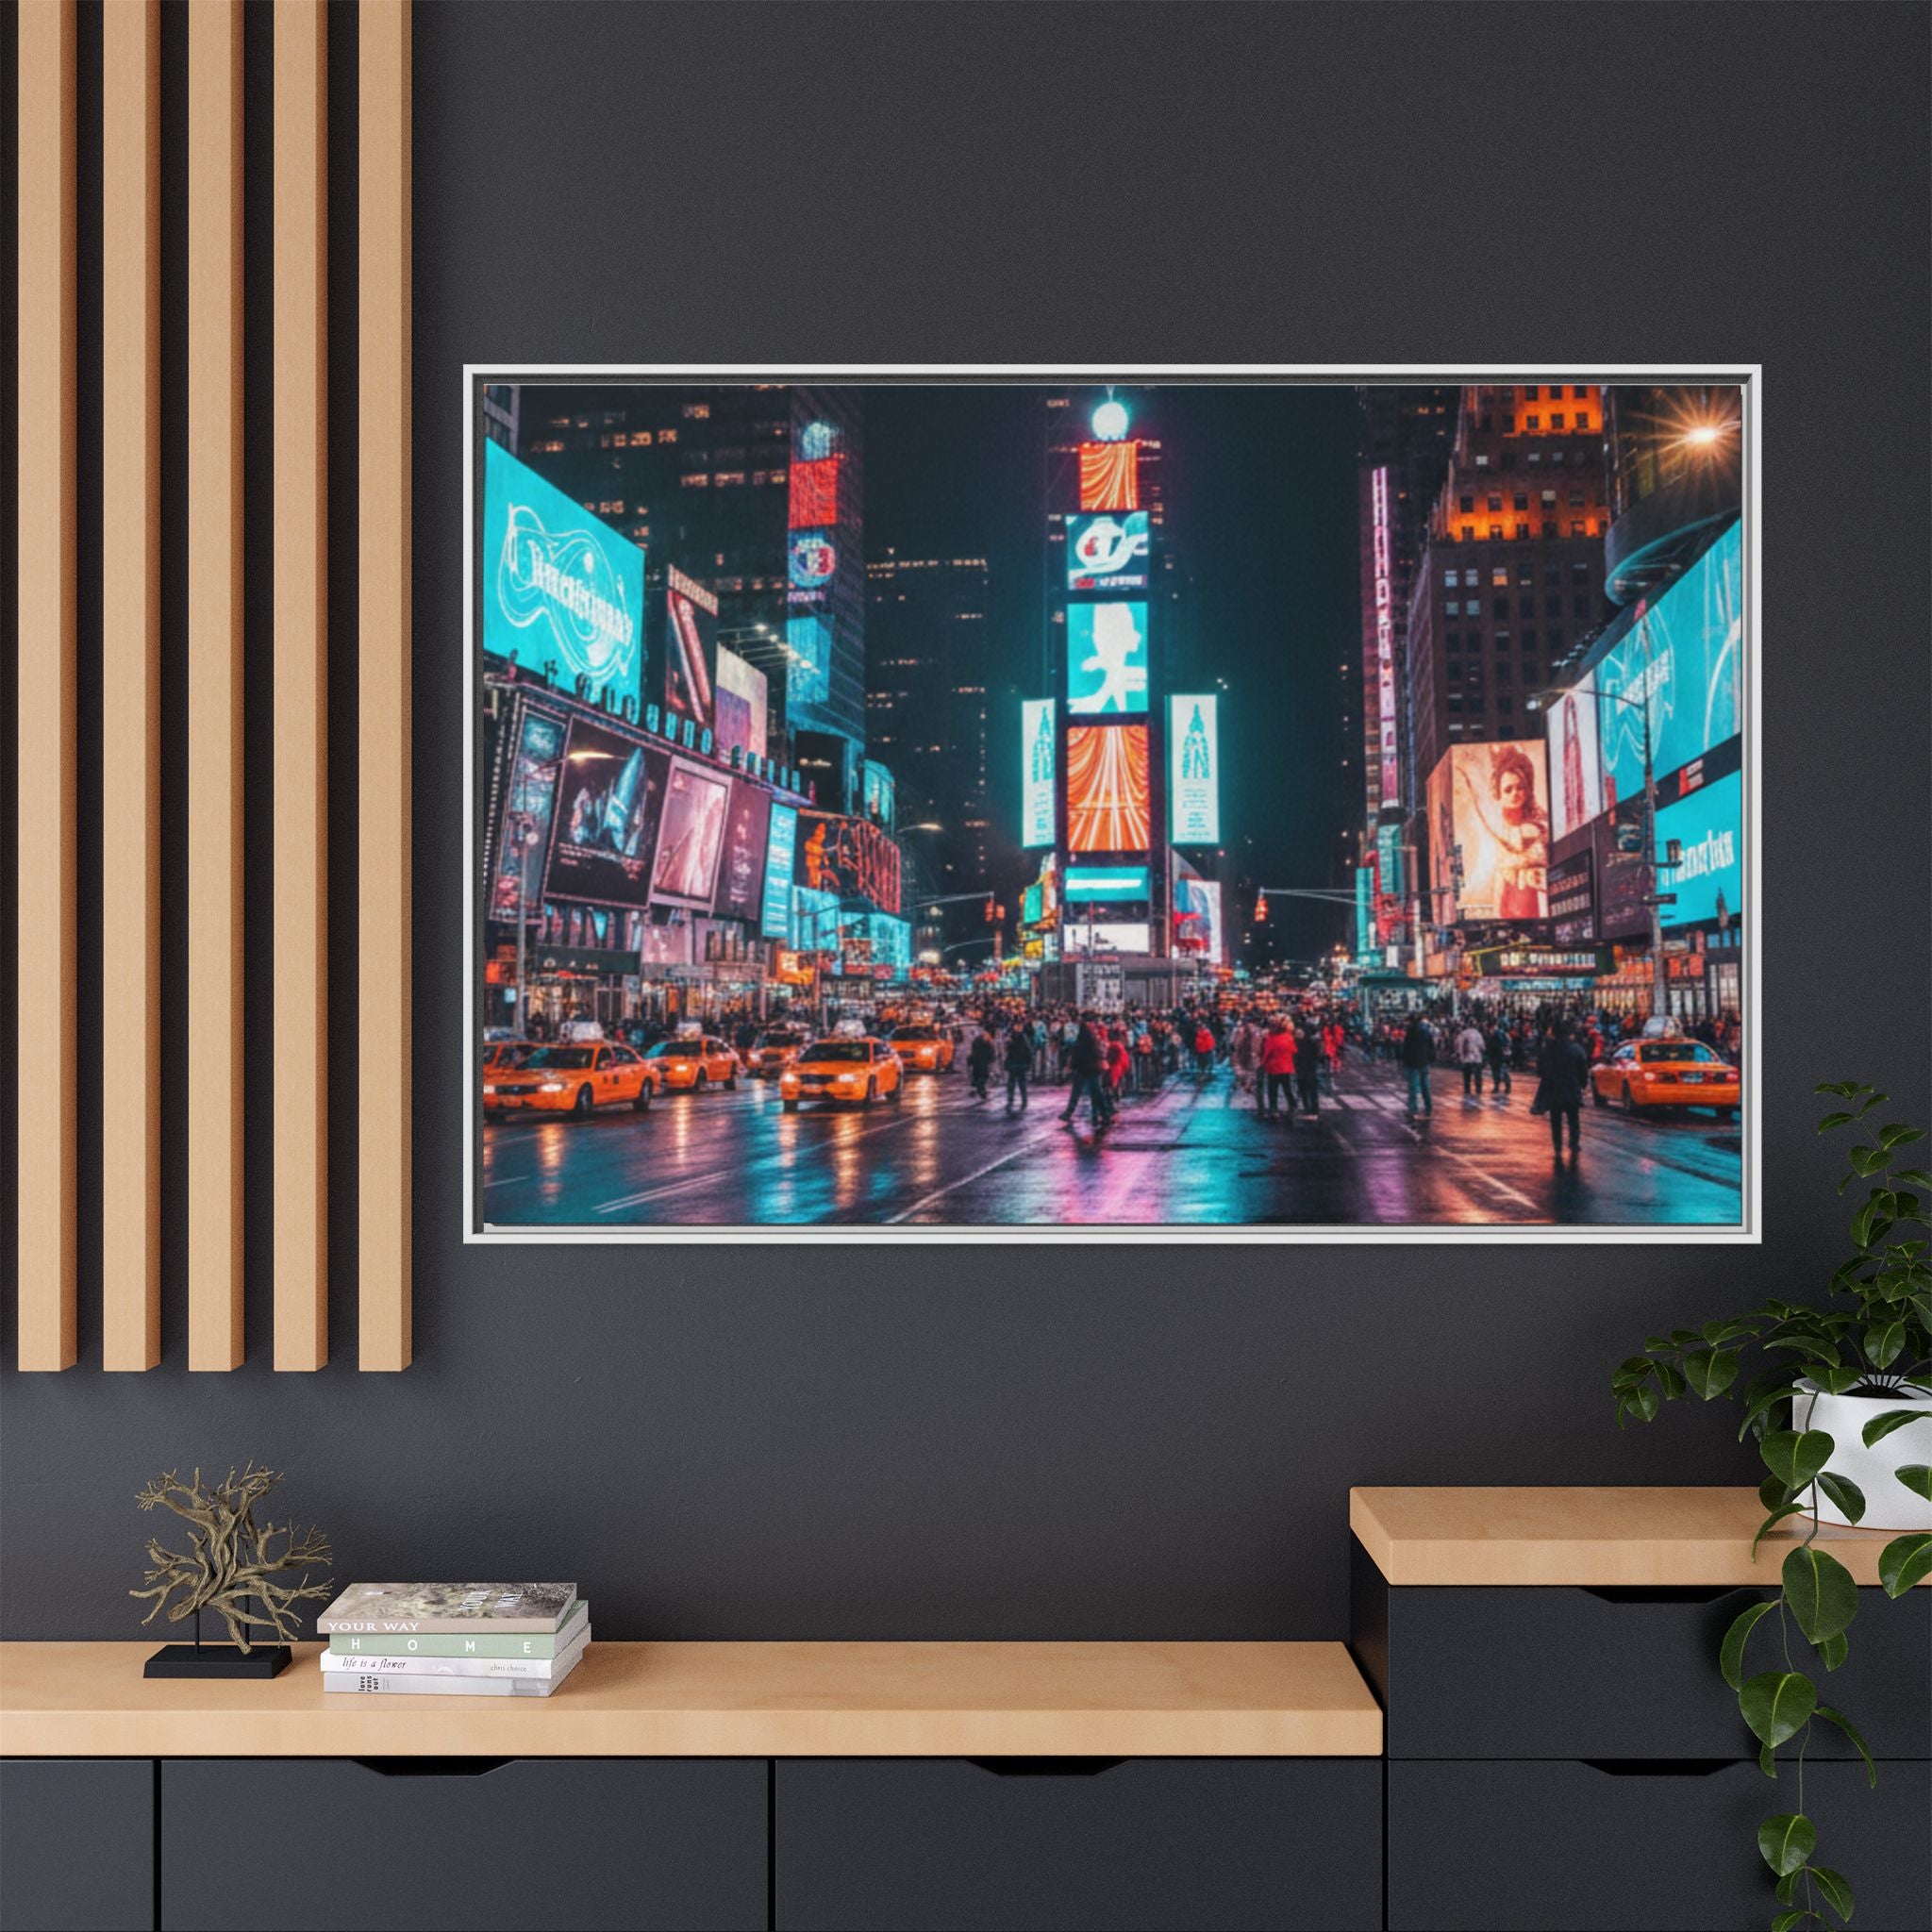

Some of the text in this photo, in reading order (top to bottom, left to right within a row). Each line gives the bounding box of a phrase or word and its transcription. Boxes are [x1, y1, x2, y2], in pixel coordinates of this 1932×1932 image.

[328, 1622, 421, 1632] YOUR WAY
[341, 1657, 358, 1672] life
[359, 1658, 368, 1668] is
[376, 1657, 408, 1673] flower
